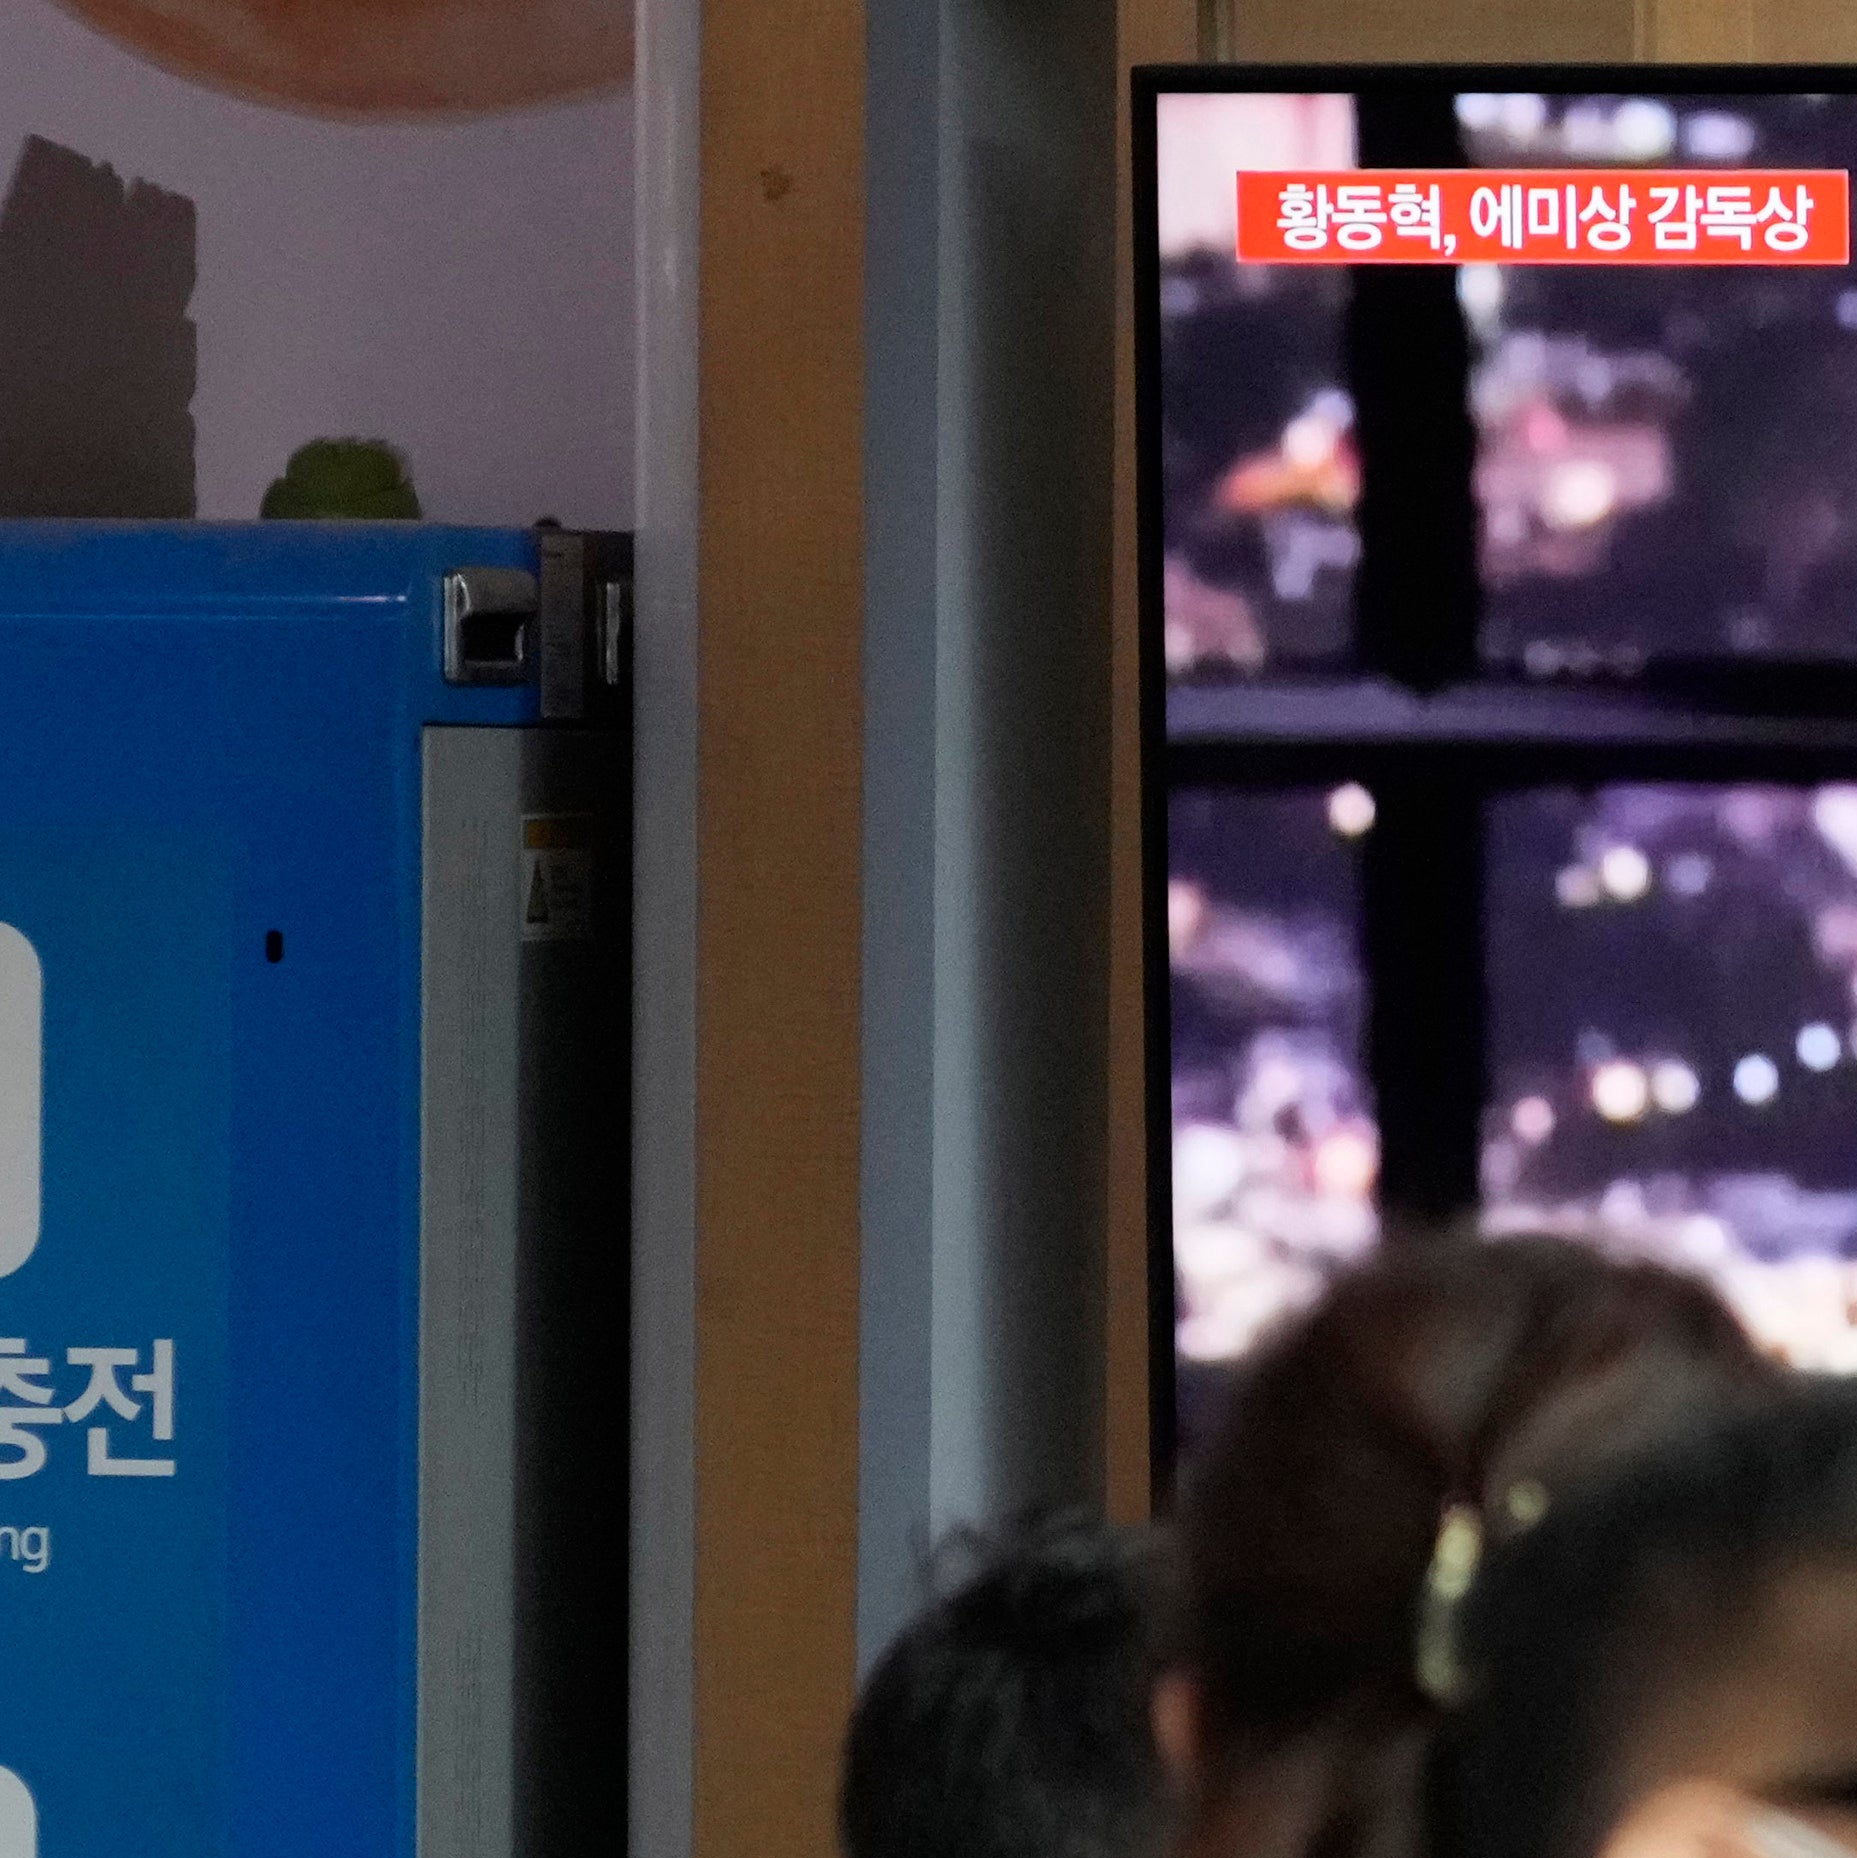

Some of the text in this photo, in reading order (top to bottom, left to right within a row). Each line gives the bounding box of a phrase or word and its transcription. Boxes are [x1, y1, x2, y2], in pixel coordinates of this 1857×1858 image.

[1275, 183, 1815, 257] 황동혁, 에미상 감독상
